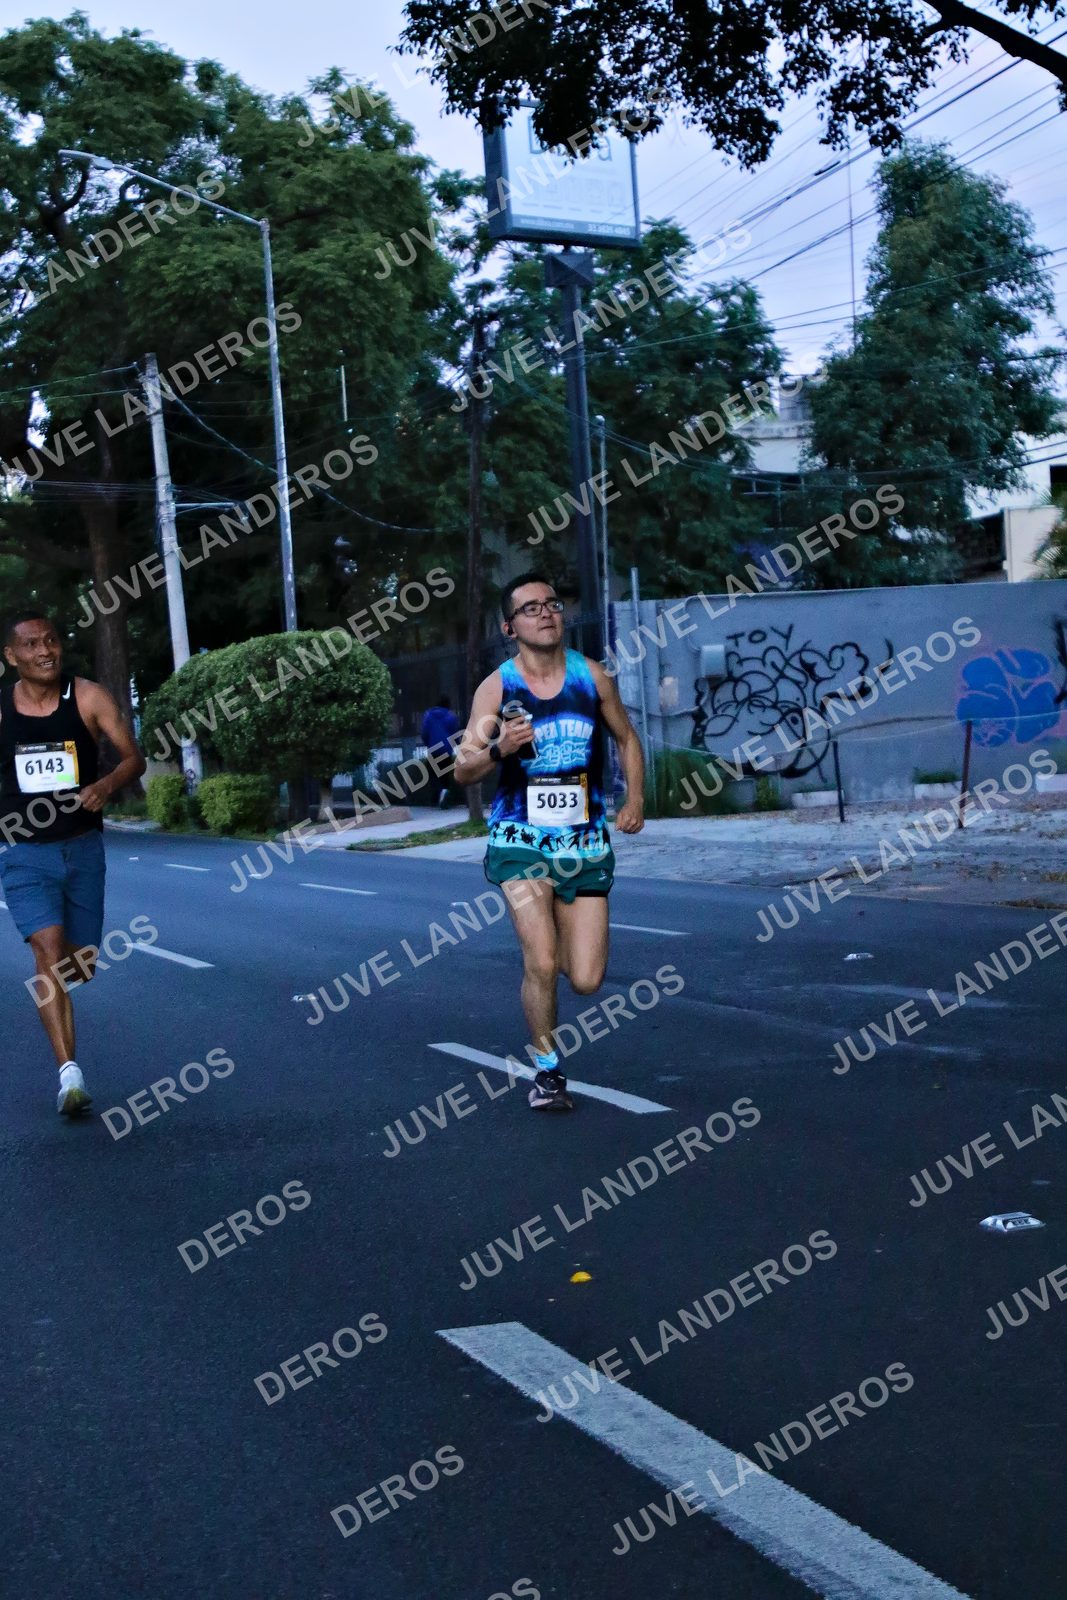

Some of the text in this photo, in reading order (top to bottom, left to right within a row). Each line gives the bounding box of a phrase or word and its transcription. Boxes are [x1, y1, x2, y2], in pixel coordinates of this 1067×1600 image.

[726, 624, 794, 651] TOY
[559, 718, 594, 740] TEAM
[25, 757, 65, 776] 6143
[536, 791, 579, 809] 5033
